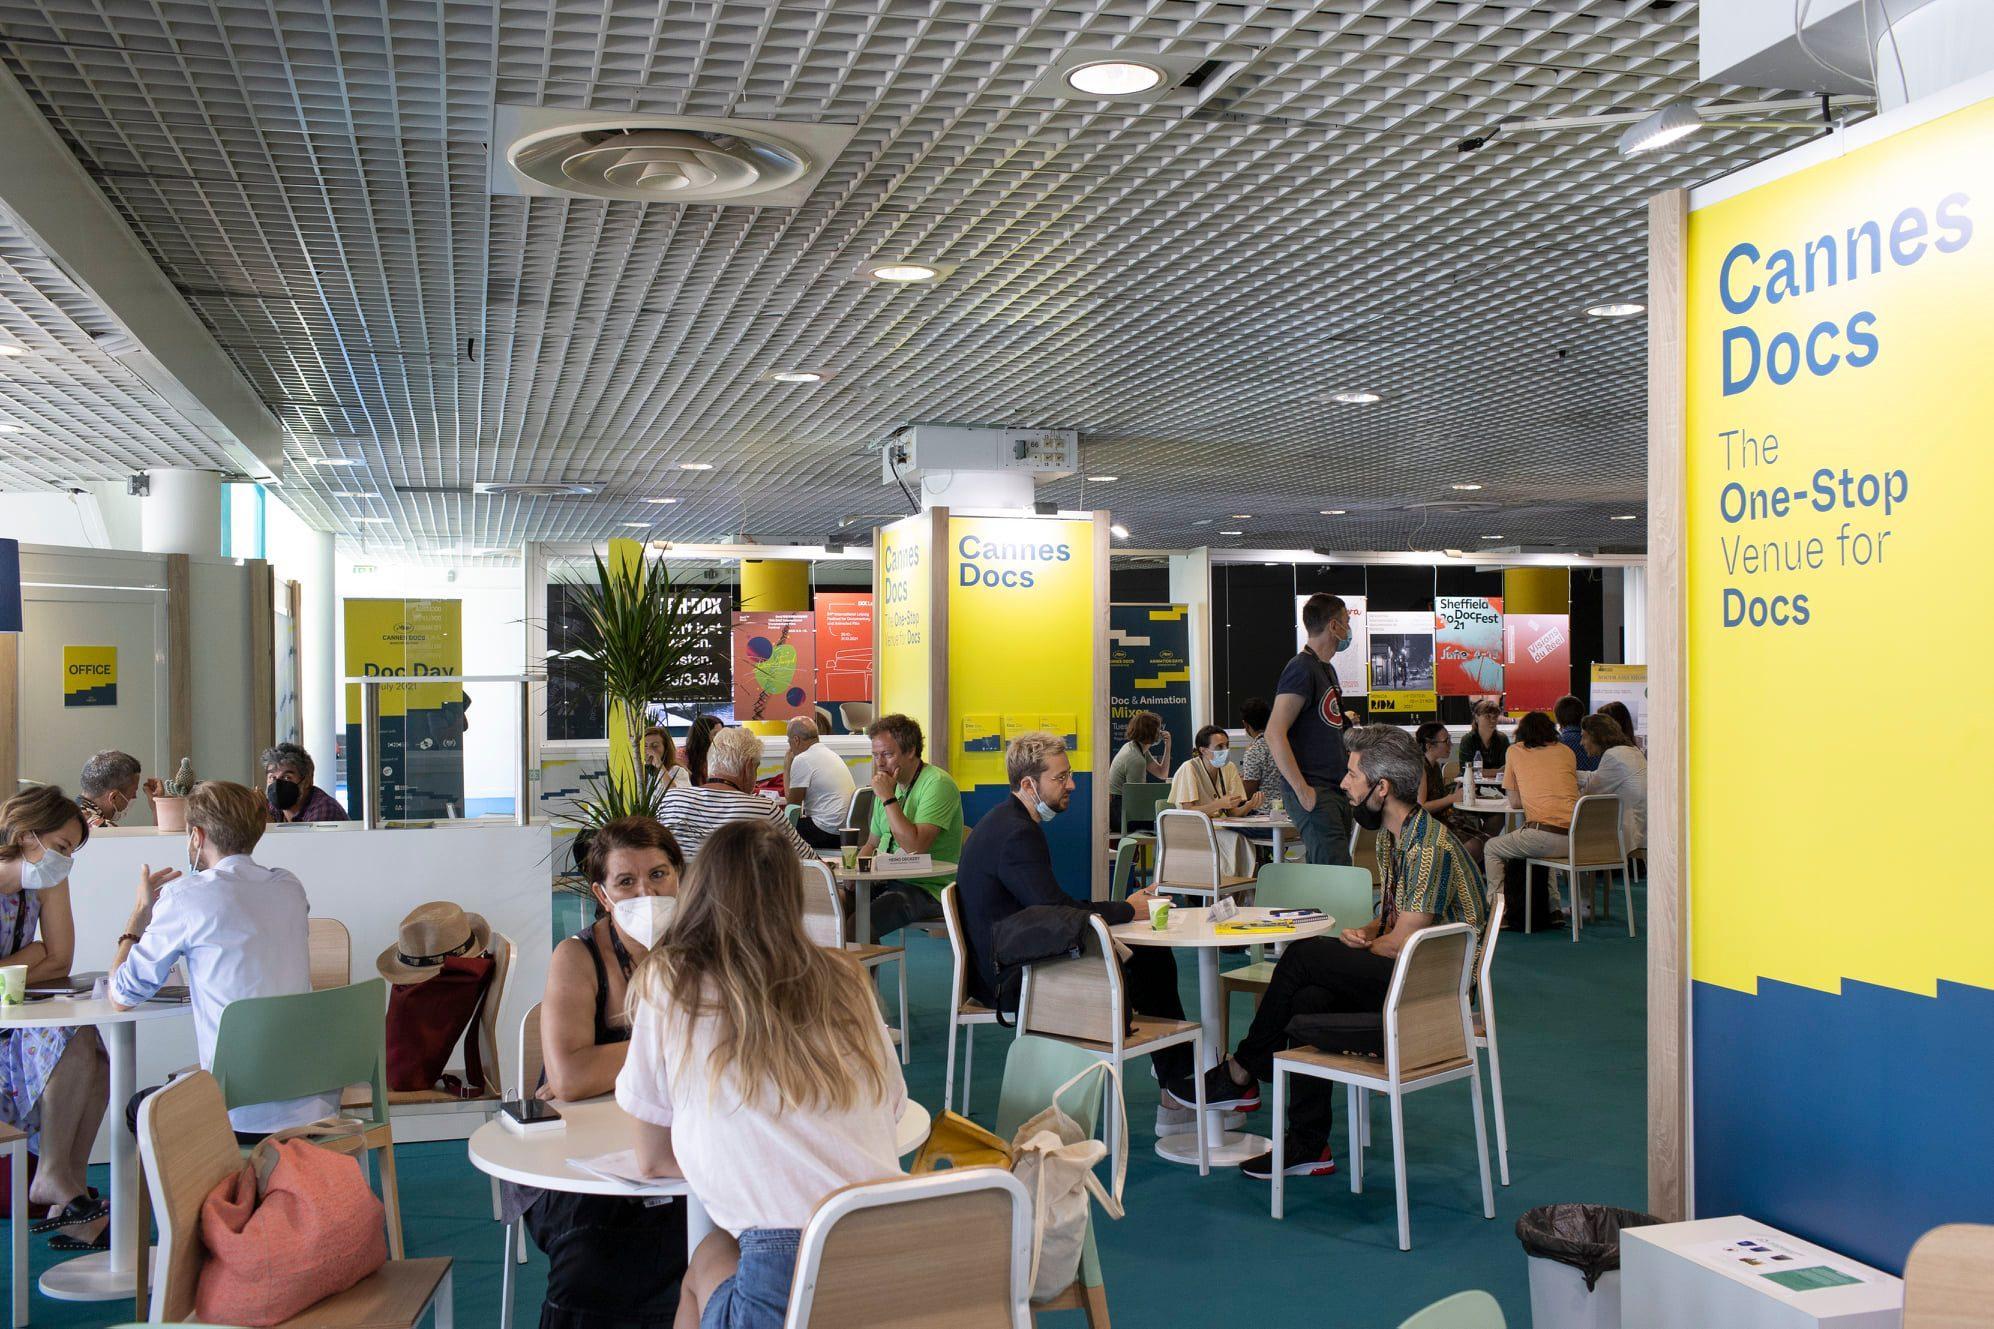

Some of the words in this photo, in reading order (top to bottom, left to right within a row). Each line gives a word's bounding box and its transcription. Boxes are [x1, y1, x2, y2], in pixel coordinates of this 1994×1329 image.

[1719, 191, 1974, 316] Cannes
[1722, 309, 1880, 398] Docs
[1718, 428, 1780, 471] The
[1720, 467, 1909, 524] One-Stop
[885, 544, 919, 574] Cannes
[958, 534, 1071, 562] Cannes
[1720, 535, 1824, 576] Venue
[1836, 523, 1892, 567] for
[959, 562, 1035, 588] Docs
[885, 577, 908, 605] Docs
[1440, 598, 1489, 609] Sheffield
[1722, 587, 1811, 628] Docs
[907, 629, 921, 645] Docs
[1453, 620, 1465, 630] 21
[1529, 628, 1559, 653] Visions
[1534, 650, 1546, 662] du
[68, 664, 112, 675] OFFICE
[364, 662, 406, 677] Doc
[413, 662, 455, 678] Day
[381, 682, 394, 691] uly
[1111, 696, 1130, 705] Doc
[1131, 696, 1138, 705] &
[1139, 695, 1187, 705] Animation
